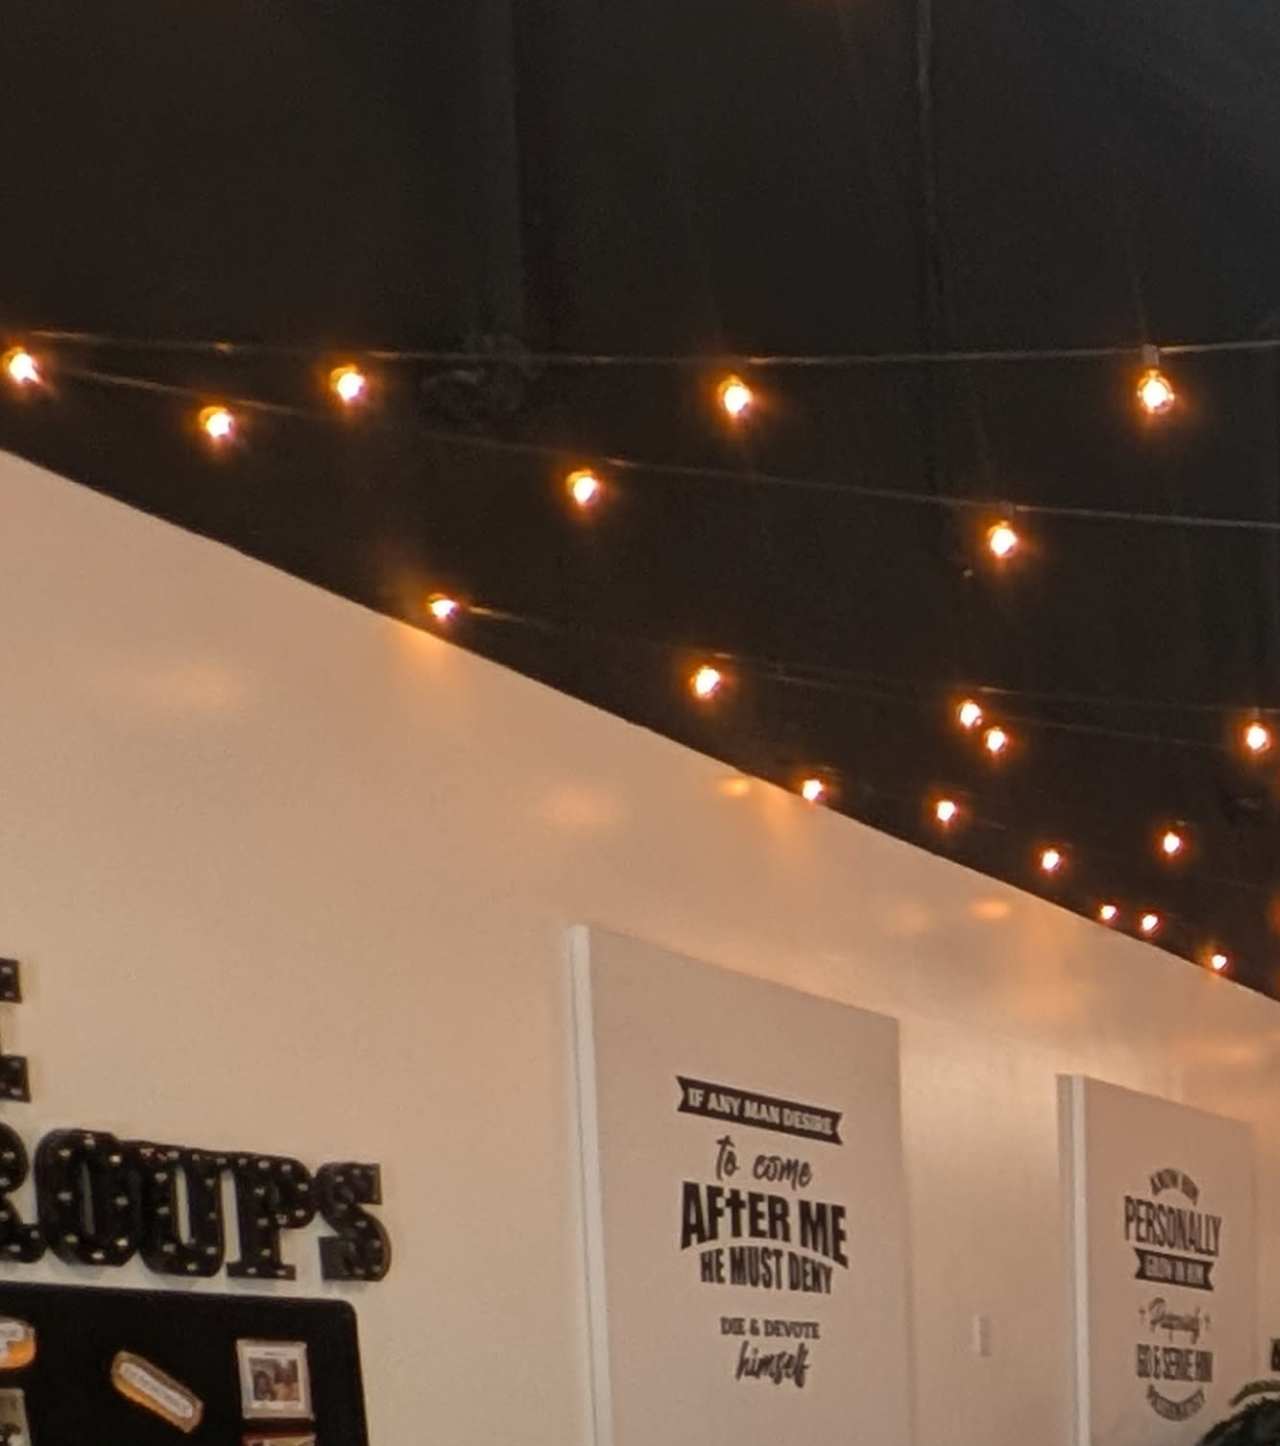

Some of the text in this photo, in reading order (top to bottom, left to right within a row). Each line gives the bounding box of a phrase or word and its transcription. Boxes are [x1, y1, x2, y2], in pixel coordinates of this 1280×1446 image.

[687, 1088, 834, 1135] IF ANY MAN DESIRE
[716, 1135, 813, 1191] to come
[798, 1199, 848, 1269] ME
[1124, 1195, 1223, 1257] PERSONALLY
[700, 1246, 833, 1294] HE MUST DENY
[720, 1317, 746, 1335] DIE
[763, 1319, 821, 1340] DEVOTE
[735, 1340, 812, 1388] himself
